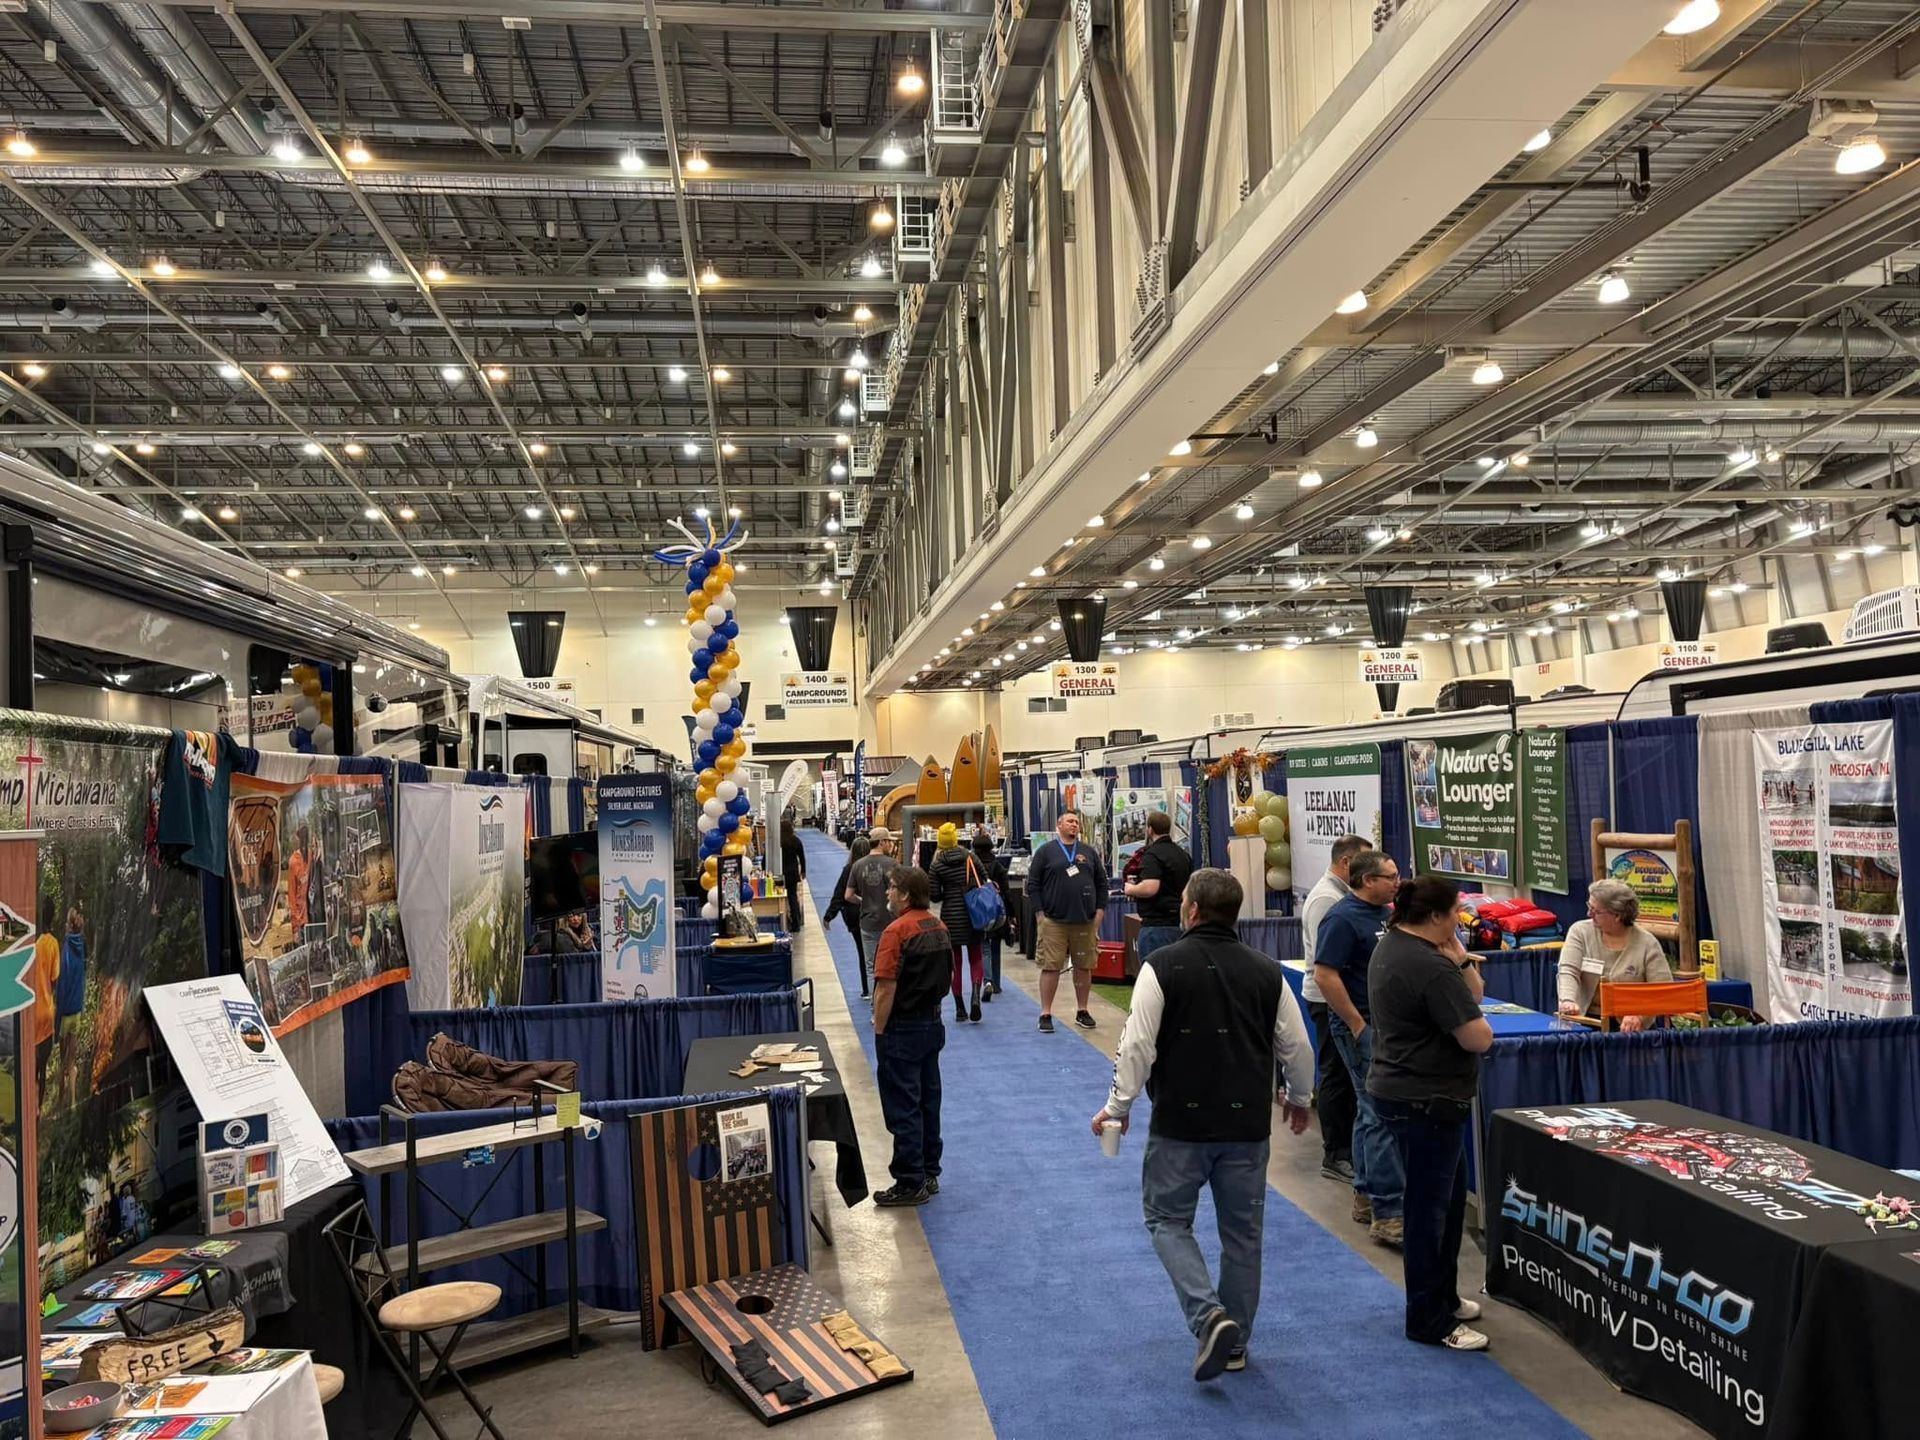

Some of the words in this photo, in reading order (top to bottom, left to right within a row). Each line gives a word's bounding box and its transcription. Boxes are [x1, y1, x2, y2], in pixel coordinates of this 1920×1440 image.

[1678, 644, 1698, 652] 1100
[1381, 652, 1401, 660] 1200
[1664, 655, 1714, 667] GENERAL
[1075, 665, 1097, 674] 1300
[1365, 663, 1417, 674] GENERAL
[1538, 664, 1550, 675] EXIT
[805, 675, 828, 683] 1400
[1060, 678, 1115, 689] GENERAL
[527, 681, 550, 690] 1500
[785, 689, 847, 698] CAMPGROUNDS
[1529, 733, 1557, 747] Nature's
[1778, 735, 1831, 756] BLUEGILL
[1834, 735, 1865, 751] LAKE
[1296, 758, 1307, 768] SITES
[1312, 757, 1329, 767] CABINS
[1334, 755, 1359, 766] GLAMPING
[1359, 753, 1374, 764] PODS
[1440, 736, 1515, 774] Nature's
[1529, 748, 1557, 761] Lounger
[1544, 765, 1553, 773] FOR
[35, 772, 117, 807] Michawana
[600, 787, 635, 798] CAMPGROUND
[636, 785, 662, 797] FEATURES
[1442, 775, 1515, 812] Lounger
[633, 802, 655, 810] MICHIGAN
[1305, 790, 1356, 812] LEELANAU
[89, 816, 97, 829] is
[1317, 815, 1345, 836] PINES
[1481, 816, 1497, 825] scoop
[1796, 829, 1815, 837] FAMILY
[1876, 832, 1893, 840] FED
[1876, 843, 1897, 851] BEAC
[1868, 918, 1895, 928] CABINS
[1828, 922, 1836, 981] RESORT
[1801, 1001, 1826, 1018] CATCH
[1502, 1244, 1595, 1318] Premium
[1632, 1316, 1765, 1426] Detailing
[1710, 1331, 1749, 1362] SHINE
[126, 1342, 191, 1384] FREE
